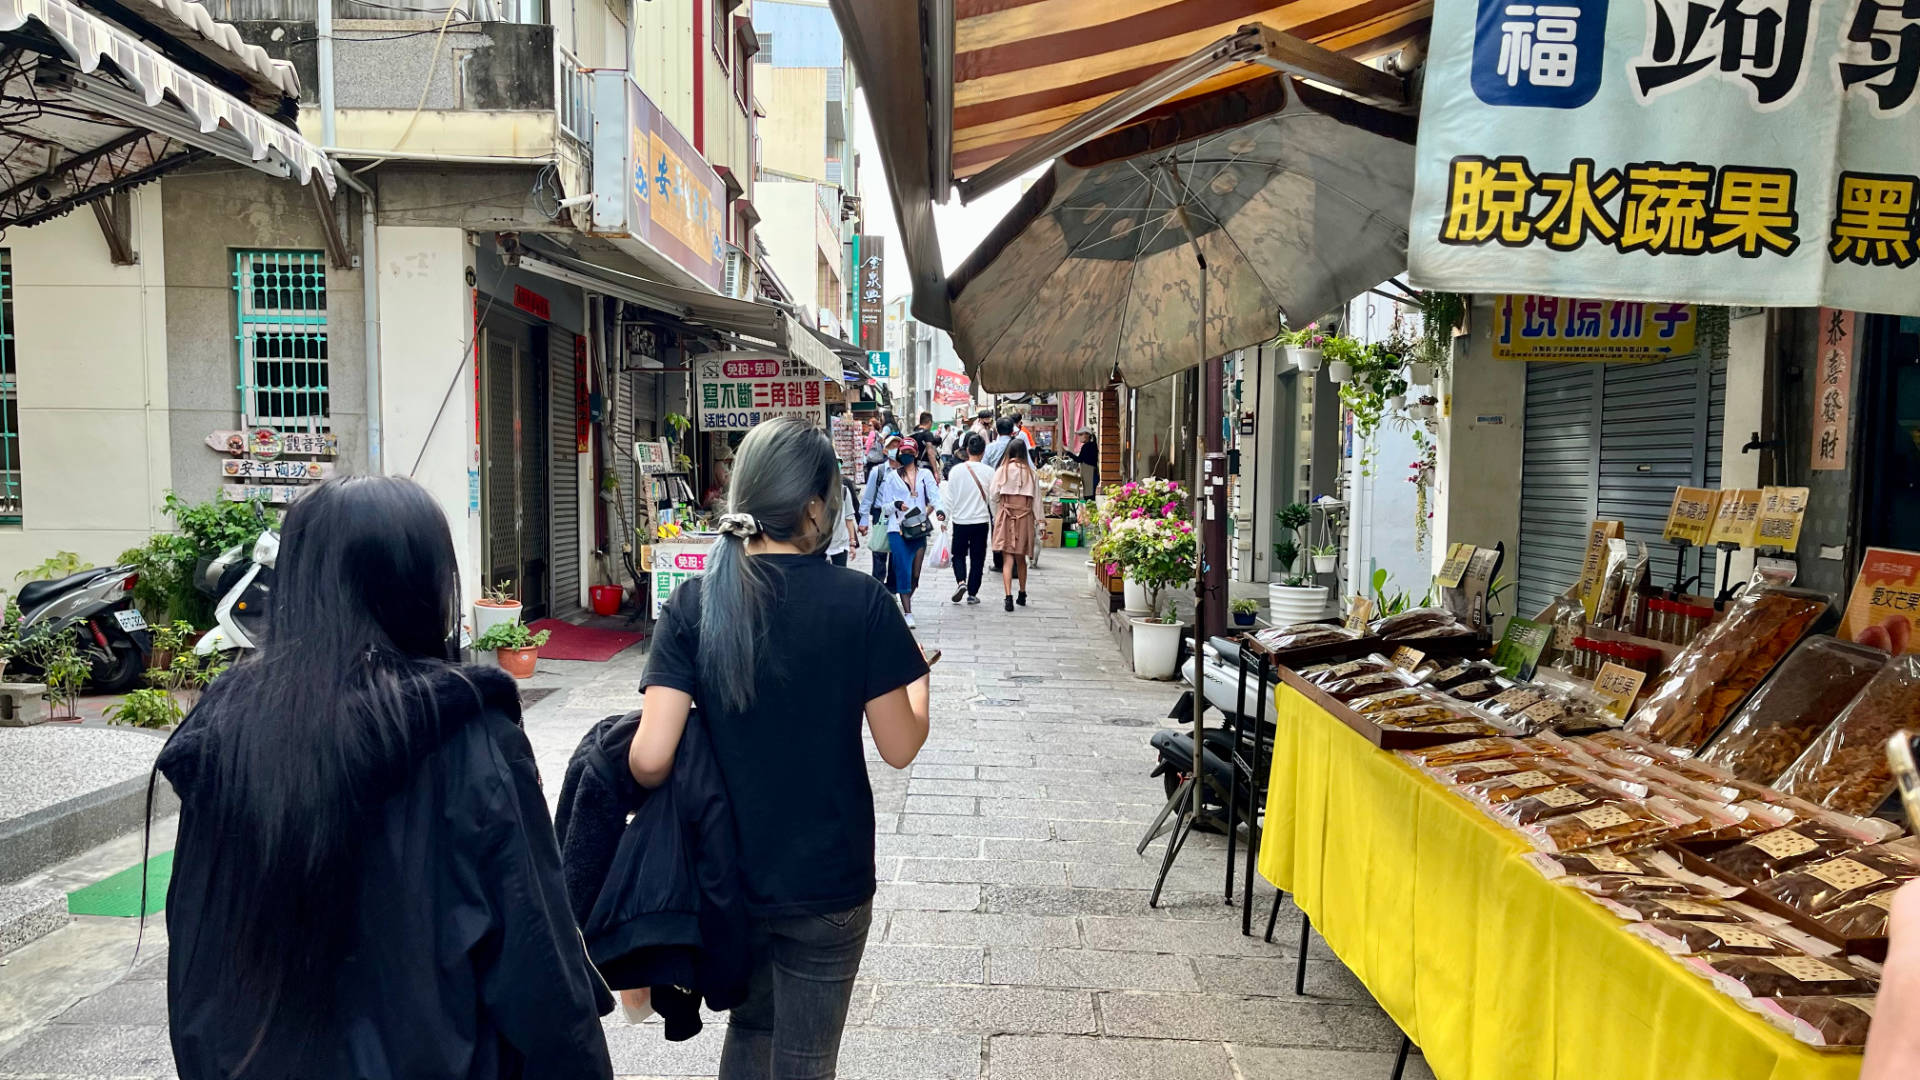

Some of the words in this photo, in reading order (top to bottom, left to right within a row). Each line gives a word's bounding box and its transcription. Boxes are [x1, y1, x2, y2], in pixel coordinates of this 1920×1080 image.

[1496, 4, 1582, 88] 福
[1440, 156, 1798, 258] 脫水蔬果
[703, 381, 821, 409] 寫不斷三角鉛筆
[1819, 309, 1848, 460] 恭喜發財
[287, 434, 326, 453] 觀音亭
[240, 460, 307, 478] 安平陶坊
[1869, 586, 1920, 612] 愛文芒果
